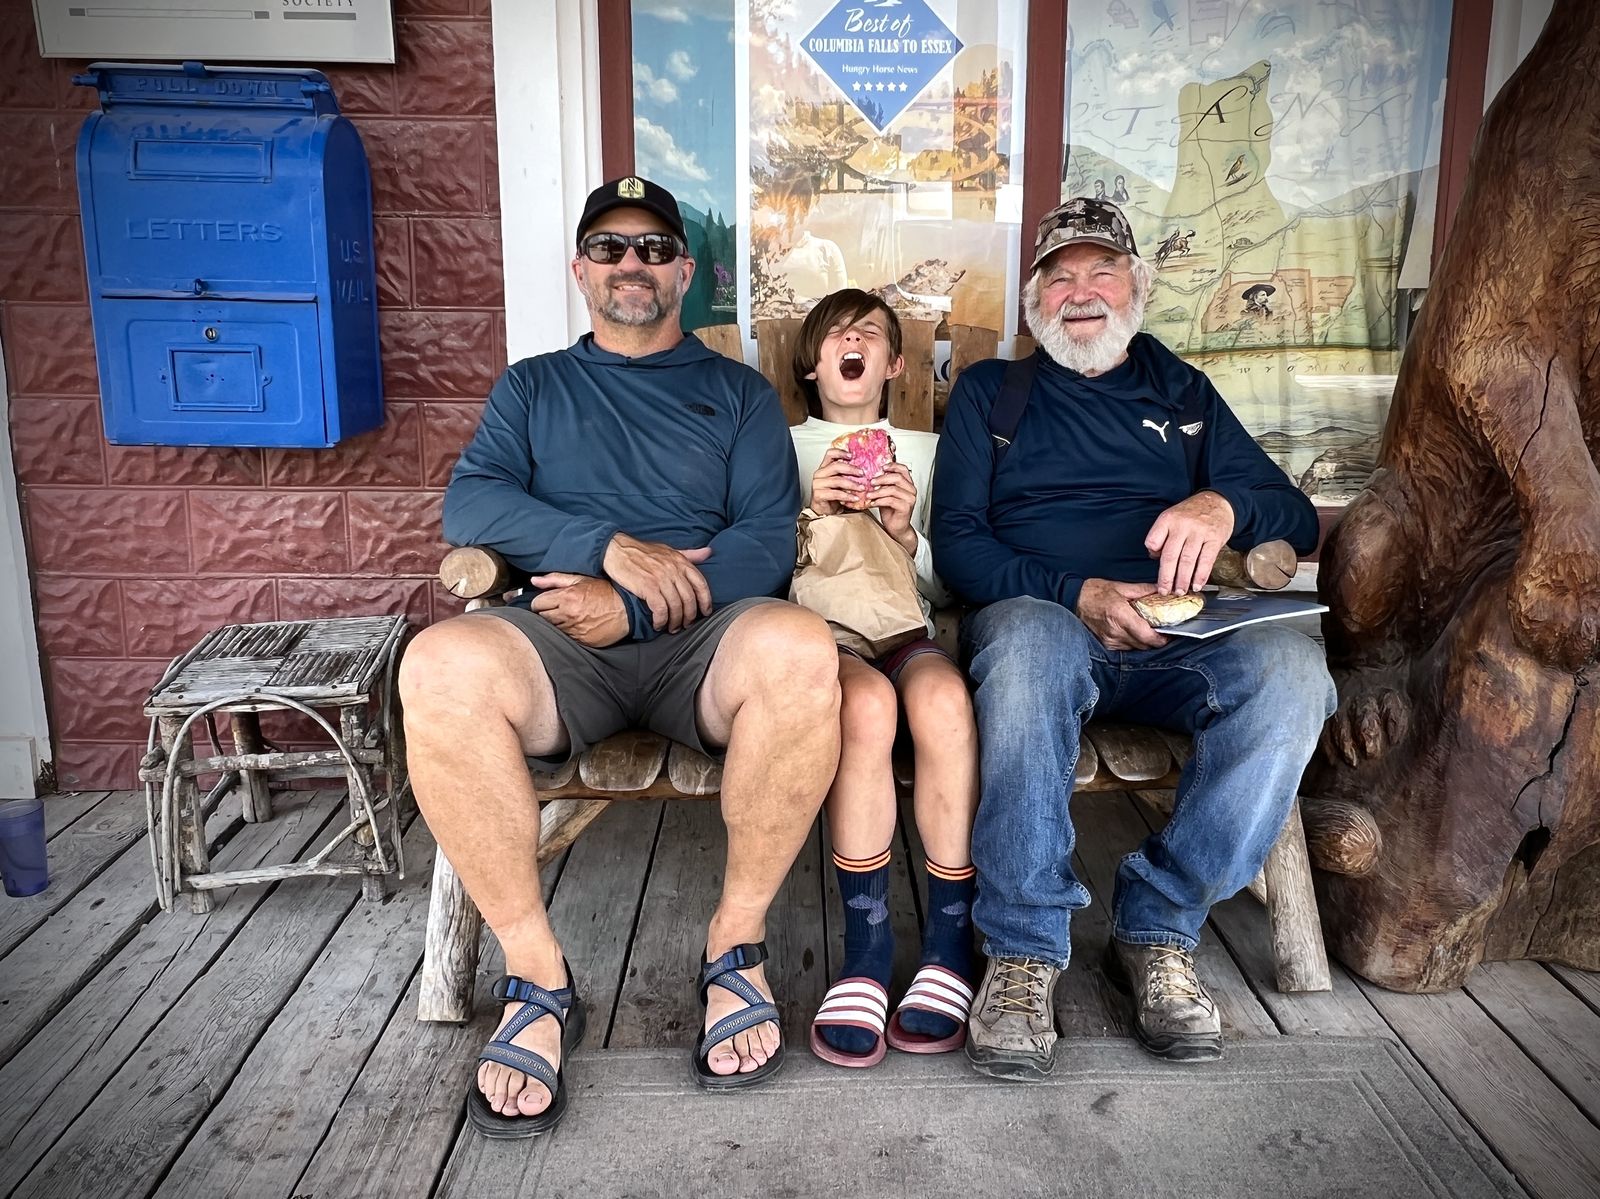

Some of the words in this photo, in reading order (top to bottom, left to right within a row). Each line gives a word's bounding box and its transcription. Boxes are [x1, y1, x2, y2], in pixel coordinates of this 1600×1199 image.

[845, 8, 888, 33] Best
[891, 14, 914, 38] of
[809, 38, 864, 53] COLUMBIA
[868, 39, 899, 53] FALLS
[902, 40, 917, 54] TO
[921, 40, 952, 54] ESSEX
[842, 64, 869, 75] Hungry
[872, 65, 894, 74] Horse
[897, 66, 918, 74] News
[136, 79, 199, 92] PULL
[215, 80, 278, 97] DOWN
[126, 218, 282, 241] LETTERS
